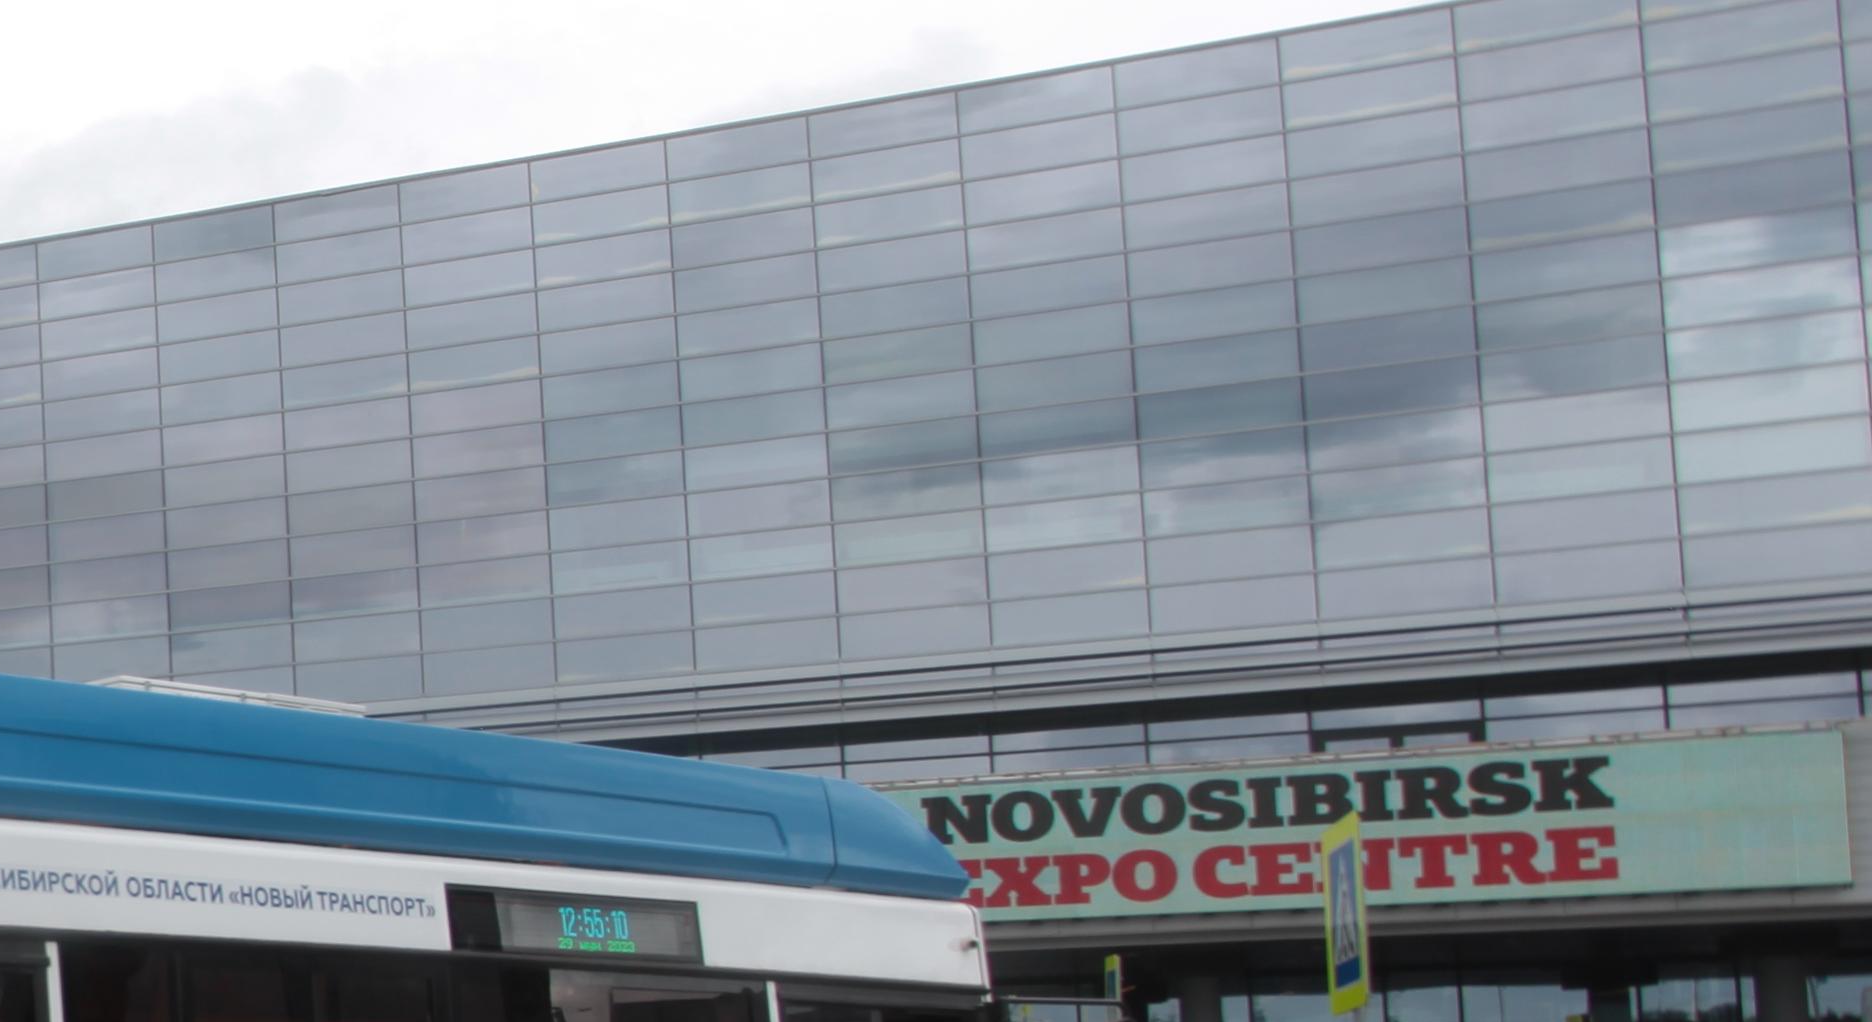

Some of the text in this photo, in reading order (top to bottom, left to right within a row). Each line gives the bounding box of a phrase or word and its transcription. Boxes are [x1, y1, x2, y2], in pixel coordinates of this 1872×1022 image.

[924, 756, 1614, 844] NOVOSIBIRSK
[126, 877, 224, 904] ОБЛАСТИ
[228, 884, 313, 911] «НОВЫЙ
[317, 891, 436, 919] ТРАНСПОРТ»
[559, 906, 629, 940] 12:55:10
